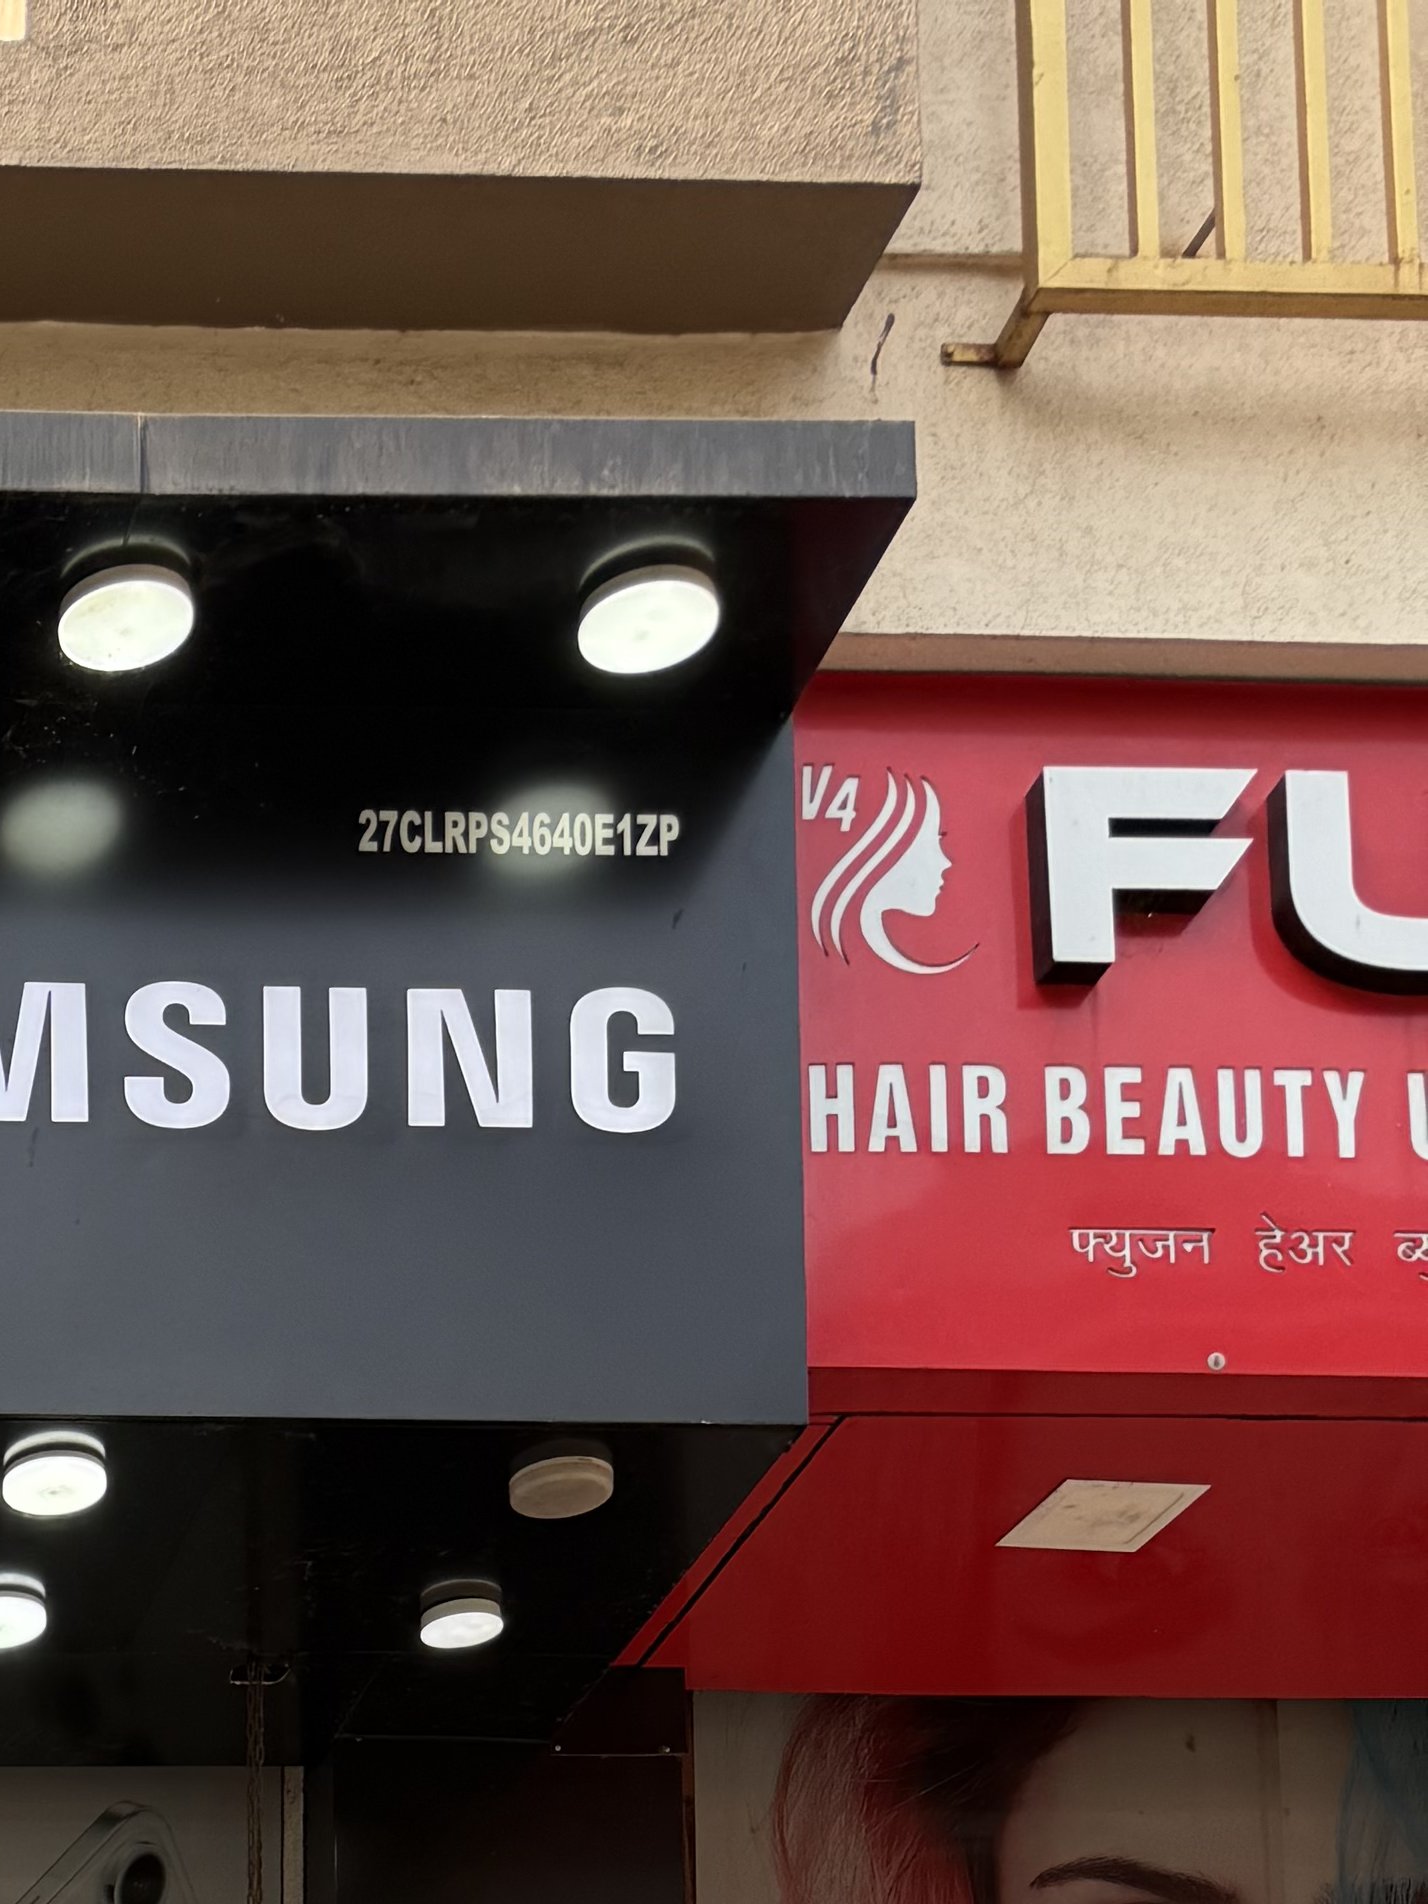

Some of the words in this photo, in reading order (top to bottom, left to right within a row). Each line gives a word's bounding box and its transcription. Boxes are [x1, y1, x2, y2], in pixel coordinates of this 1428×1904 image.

[801, 764, 859, 831] V4
[357, 809, 681, 857] 27CLRPS4640E1ZP
[808, 1064, 1008, 1153] HAIR
[1045, 1065, 1365, 1158] BEAUTY
[1070, 1228, 1214, 1277] फ्युजन
[1255, 1213, 1355, 1272] हेअर
